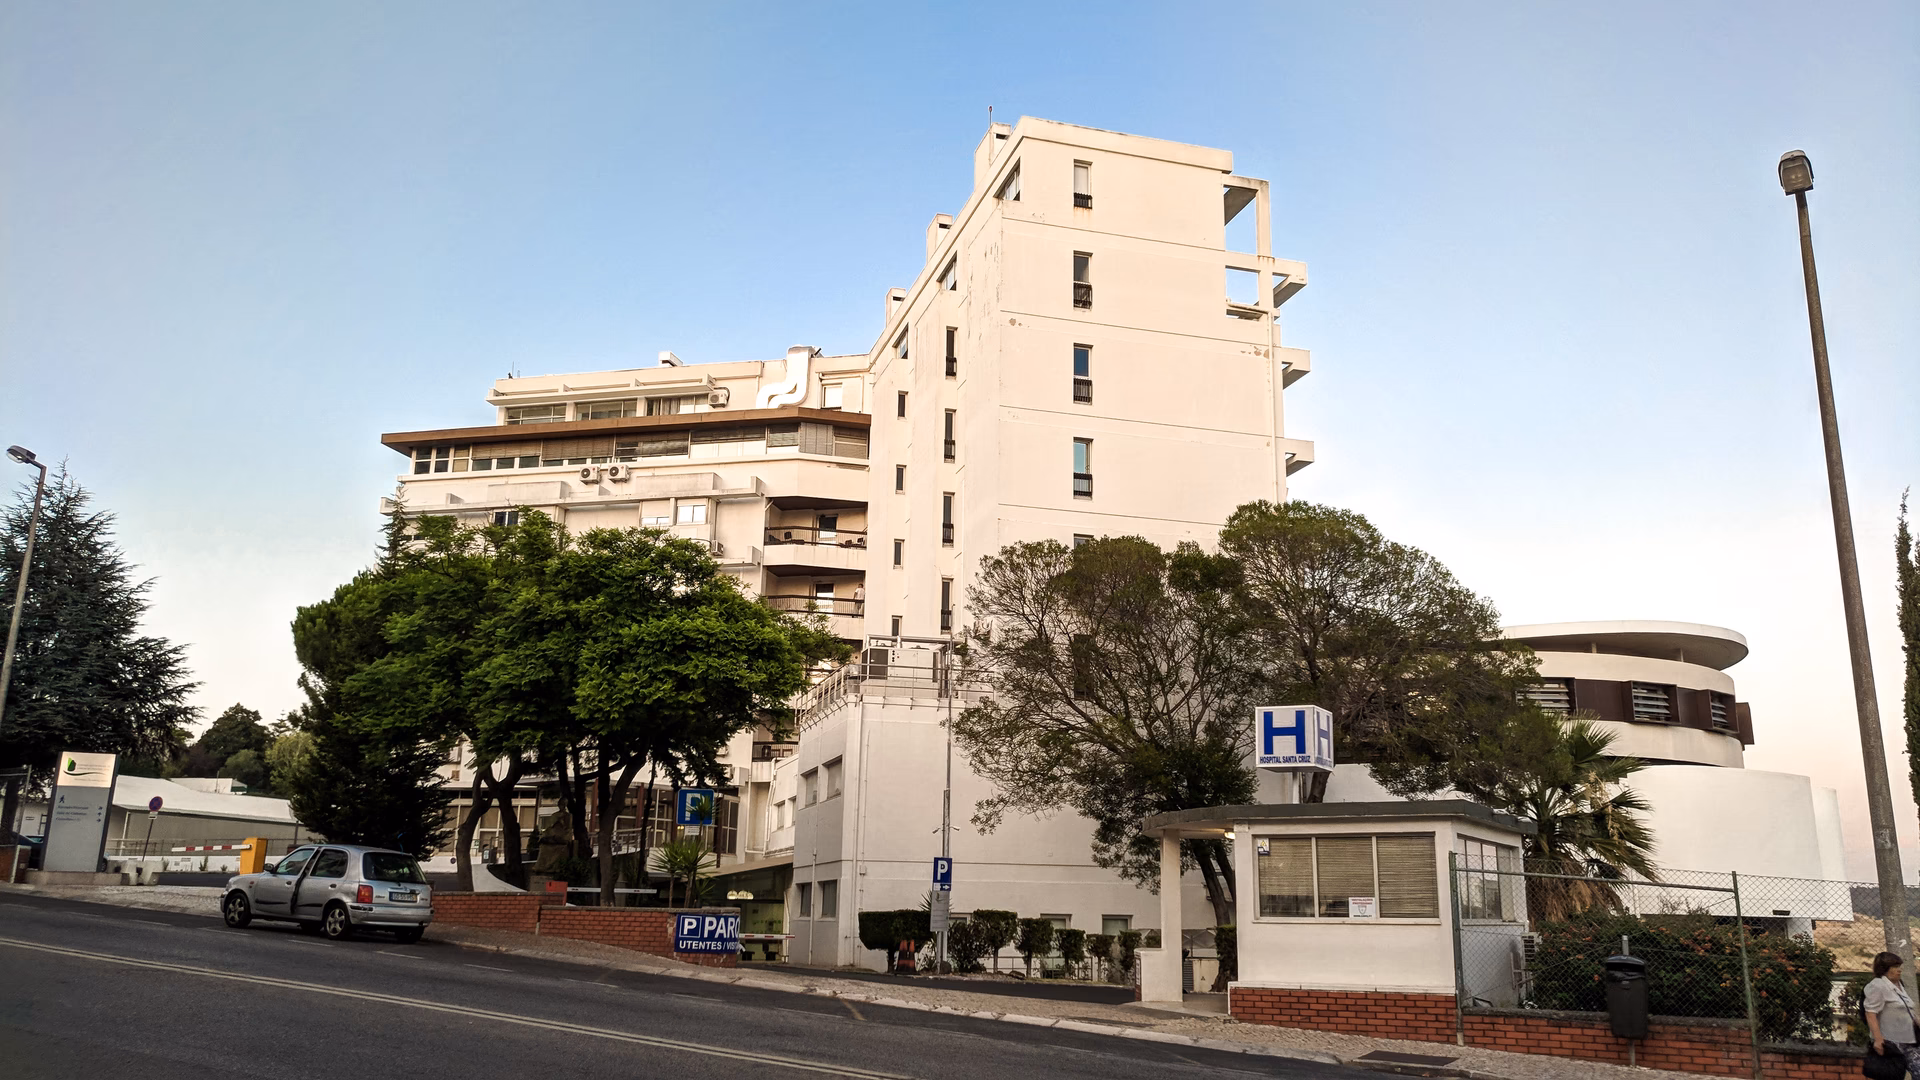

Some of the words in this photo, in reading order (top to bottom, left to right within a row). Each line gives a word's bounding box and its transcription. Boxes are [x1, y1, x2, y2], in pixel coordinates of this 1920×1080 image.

[1264, 710, 1306, 755] H
[1260, 756, 1281, 764] HOSPITAL
[1282, 755, 1297, 763] SANTA
[1298, 755, 1311, 763] CRUZ
[937, 860, 948, 881] P
[683, 918, 697, 935] P
[679, 940, 722, 950] UTENTES
